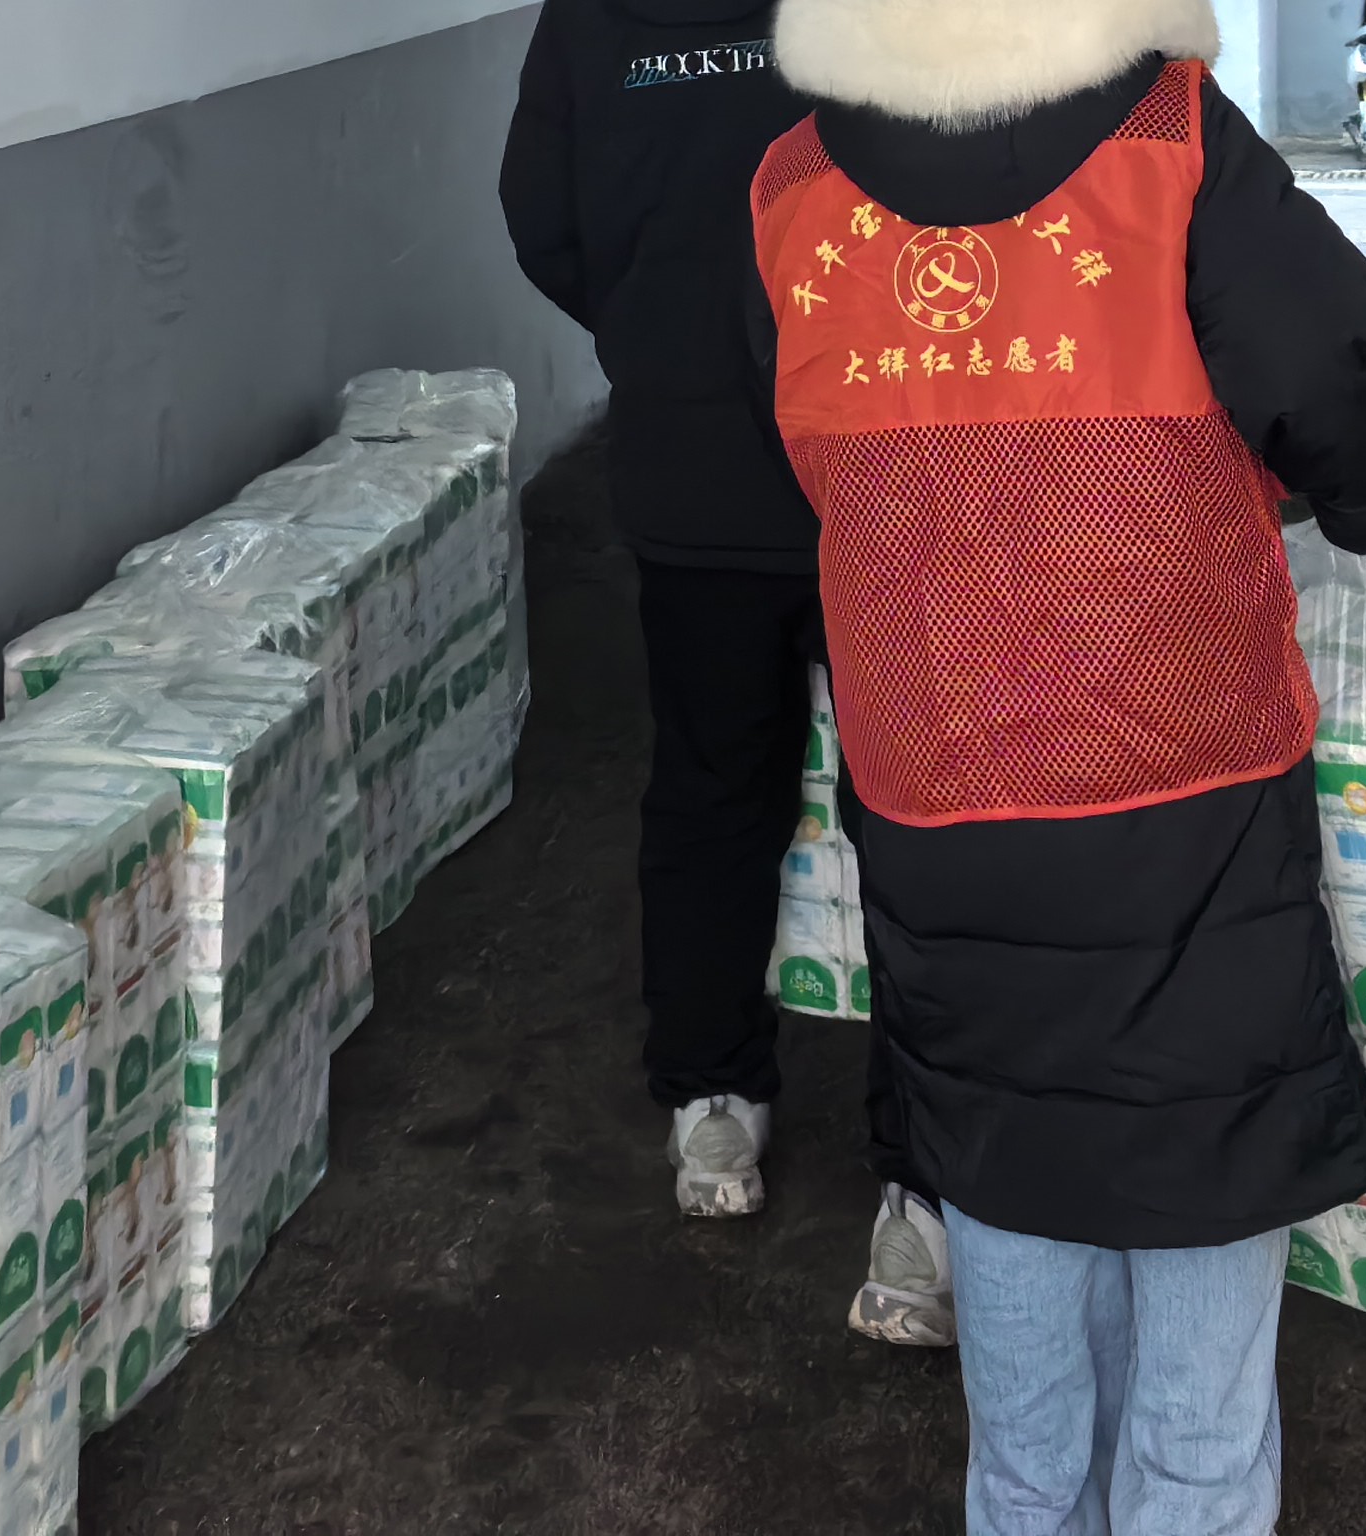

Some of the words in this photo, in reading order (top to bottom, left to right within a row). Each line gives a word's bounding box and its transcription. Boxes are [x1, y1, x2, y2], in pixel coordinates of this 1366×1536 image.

[842, 333, 1078, 385] 大祥红志愿者
